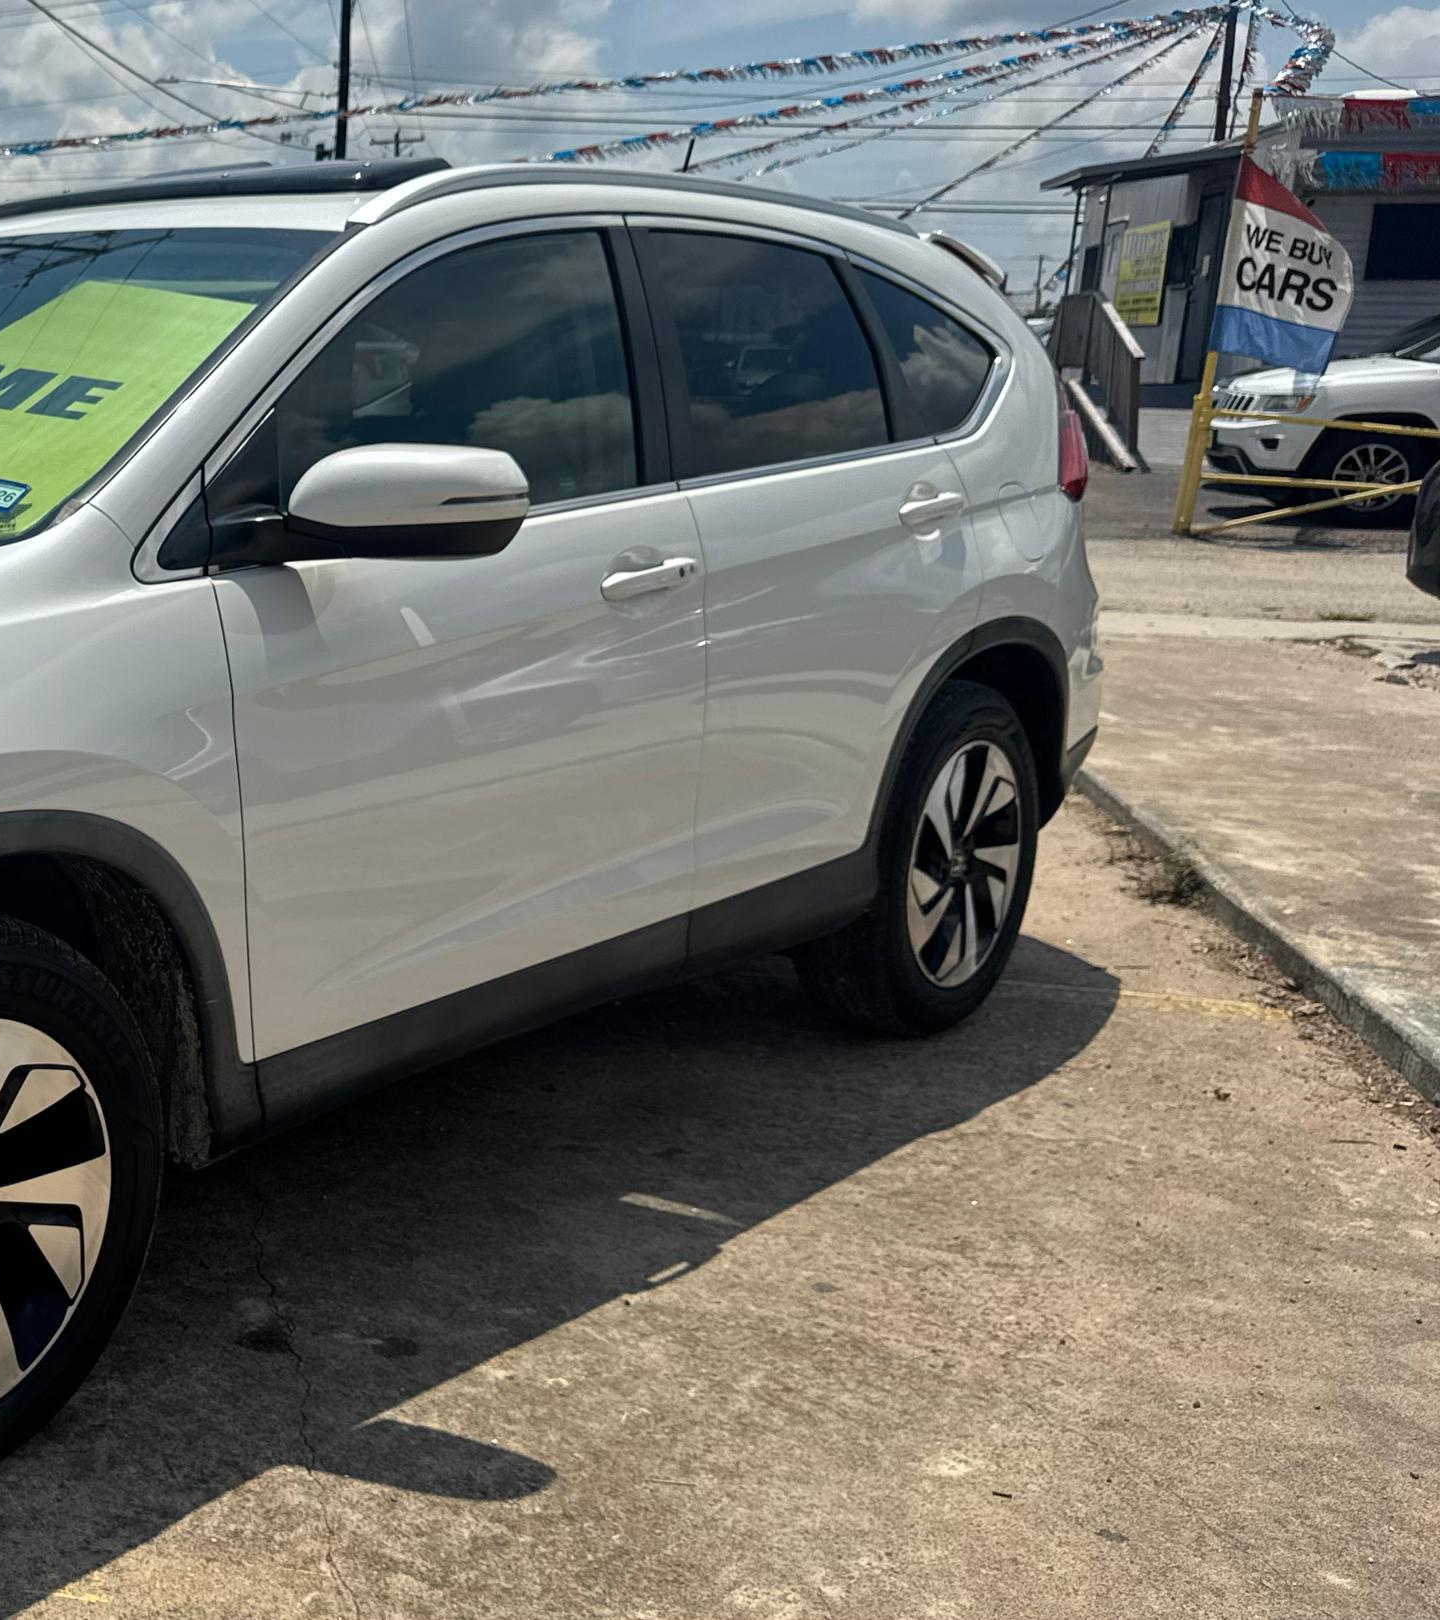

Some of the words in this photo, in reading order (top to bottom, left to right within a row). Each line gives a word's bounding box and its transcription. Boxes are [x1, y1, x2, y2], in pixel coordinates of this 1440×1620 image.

[1246, 224, 1284, 254] WE
[1288, 237, 1332, 269] BUY
[1236, 256, 1338, 312] CARS
